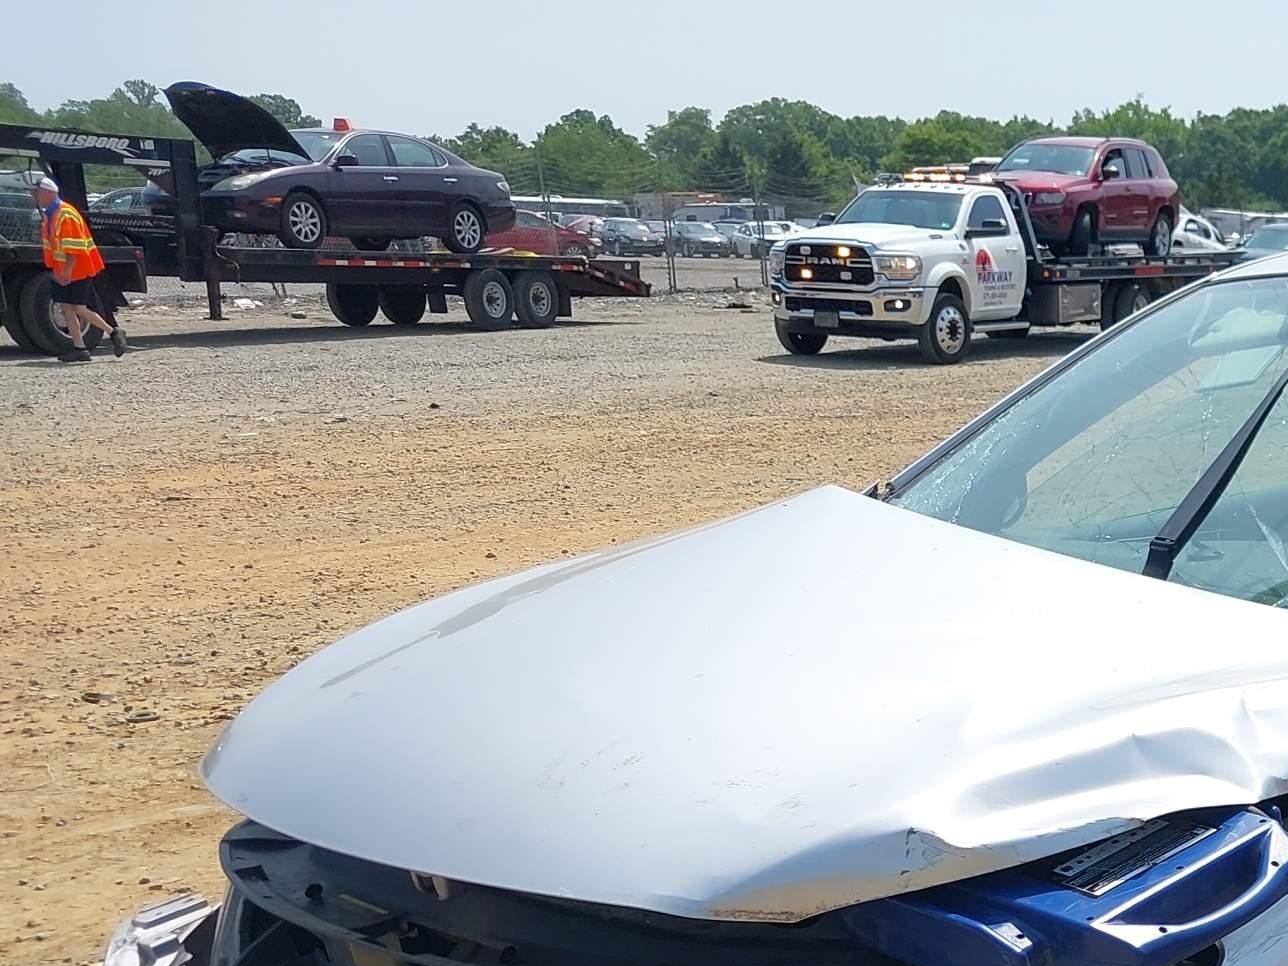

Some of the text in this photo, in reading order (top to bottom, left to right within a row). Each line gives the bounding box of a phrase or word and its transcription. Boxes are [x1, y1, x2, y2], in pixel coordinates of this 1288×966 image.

[40, 131, 130, 149] HILLSBORO
[806, 255, 845, 266] RAM
[977, 271, 1014, 284] PARKWAY
